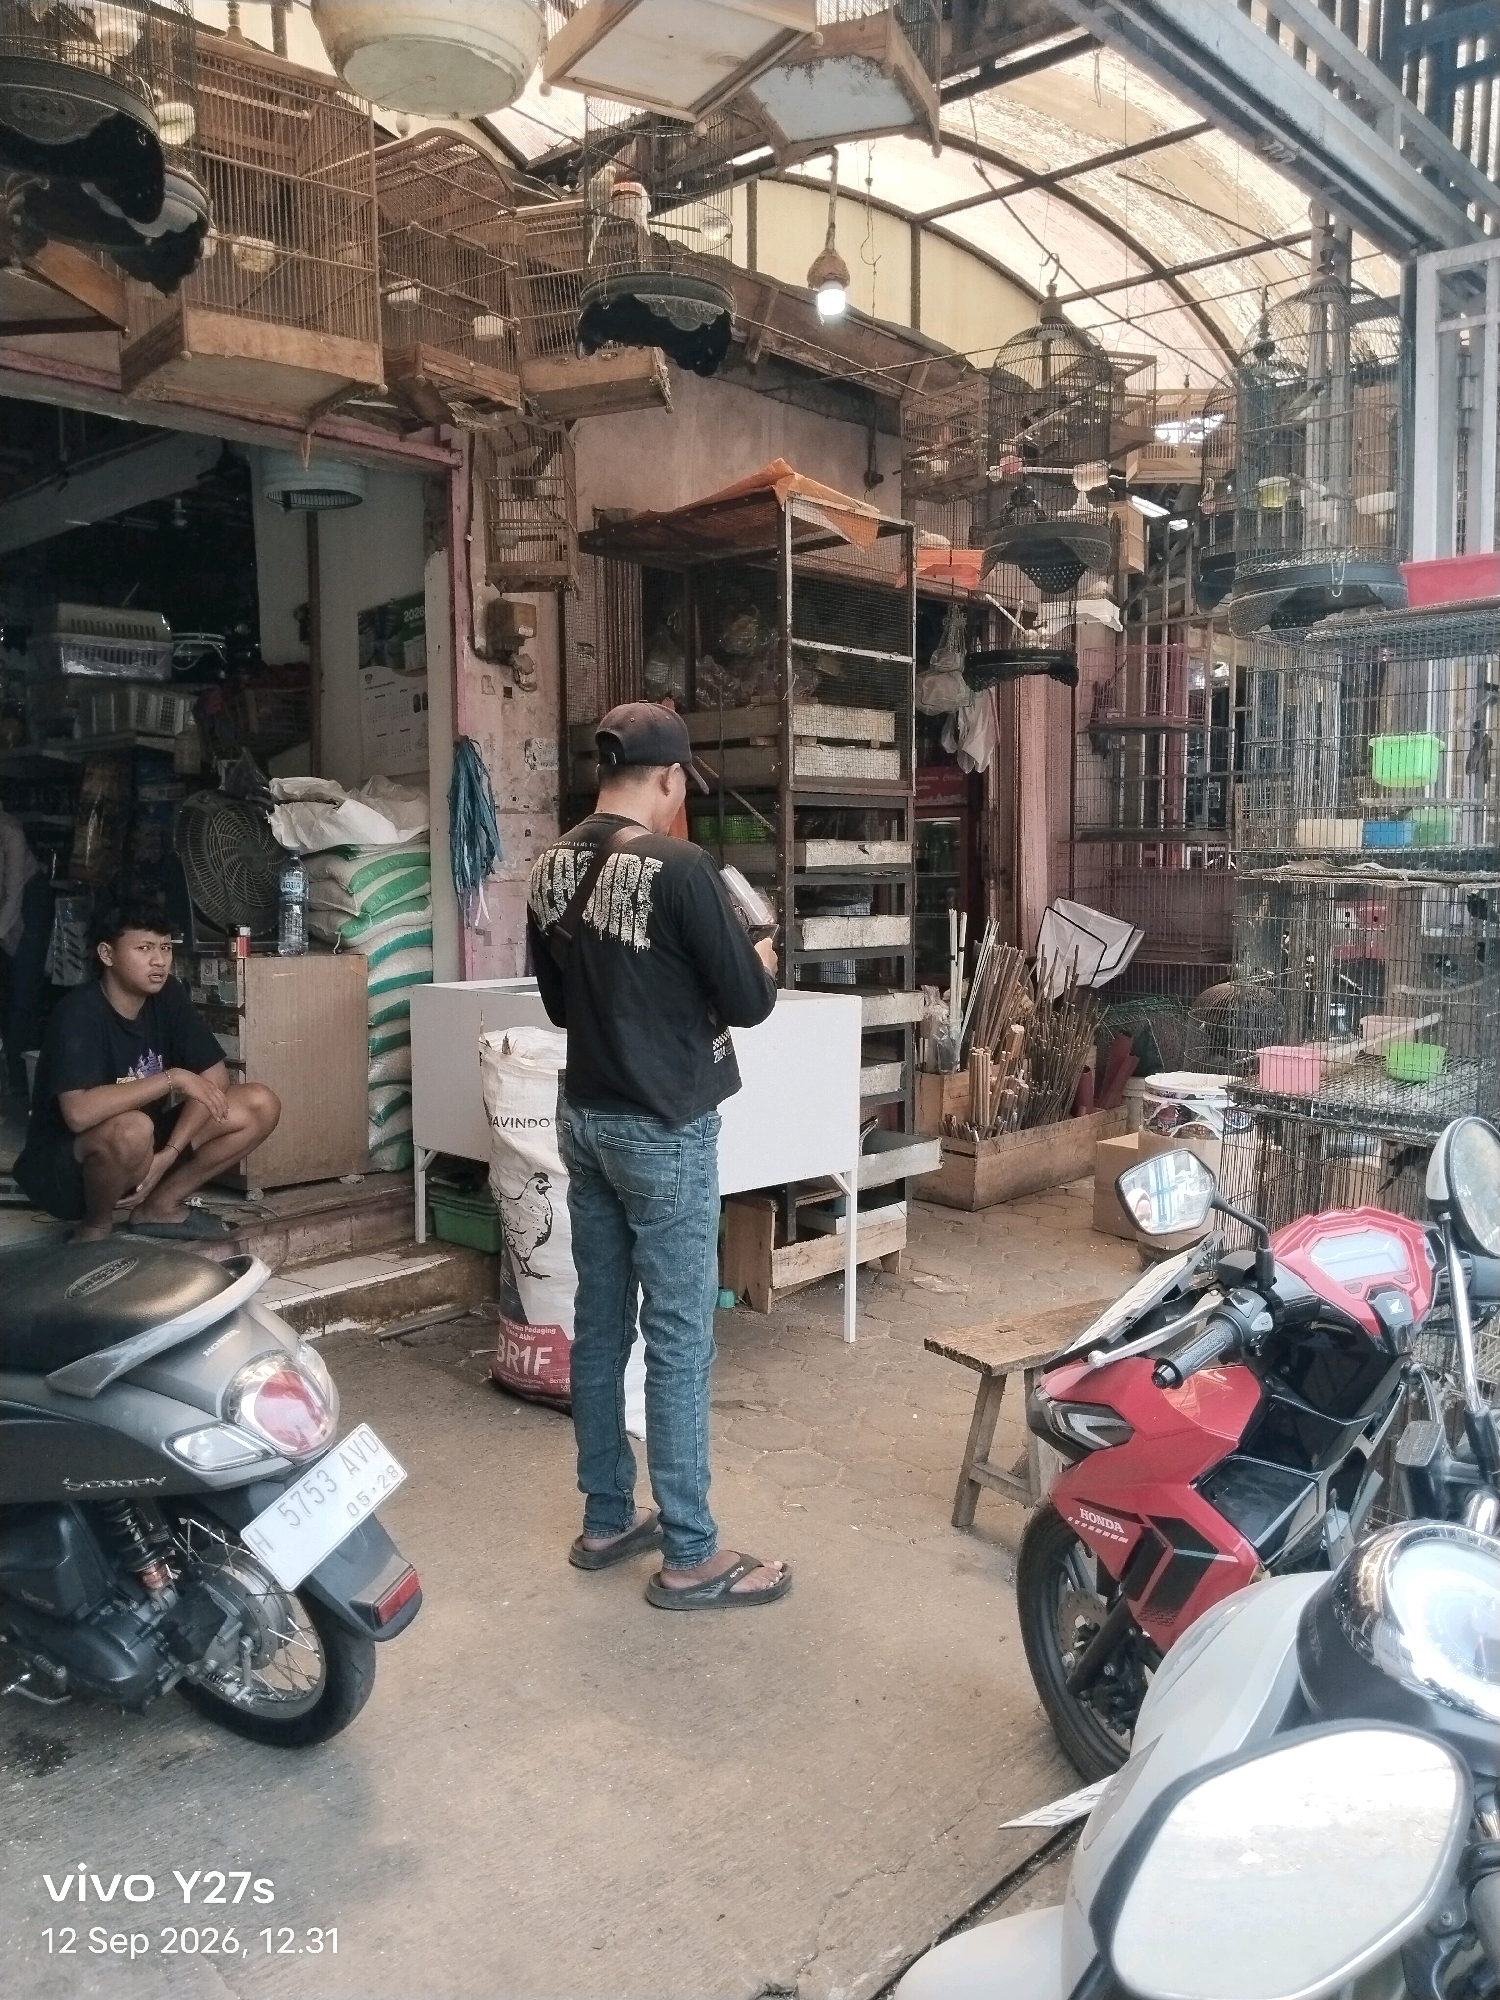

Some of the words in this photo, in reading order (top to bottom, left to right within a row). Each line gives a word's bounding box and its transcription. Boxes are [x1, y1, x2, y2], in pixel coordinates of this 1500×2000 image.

[203, 1329, 240, 1357] HONDA
[524, 1326, 556, 1335] Pedaging
[248, 1527, 275, 1557] H
[277, 1469, 338, 1528] 5753
[338, 1430, 380, 1477] AVD
[1080, 1507, 1125, 1534] HONDA
